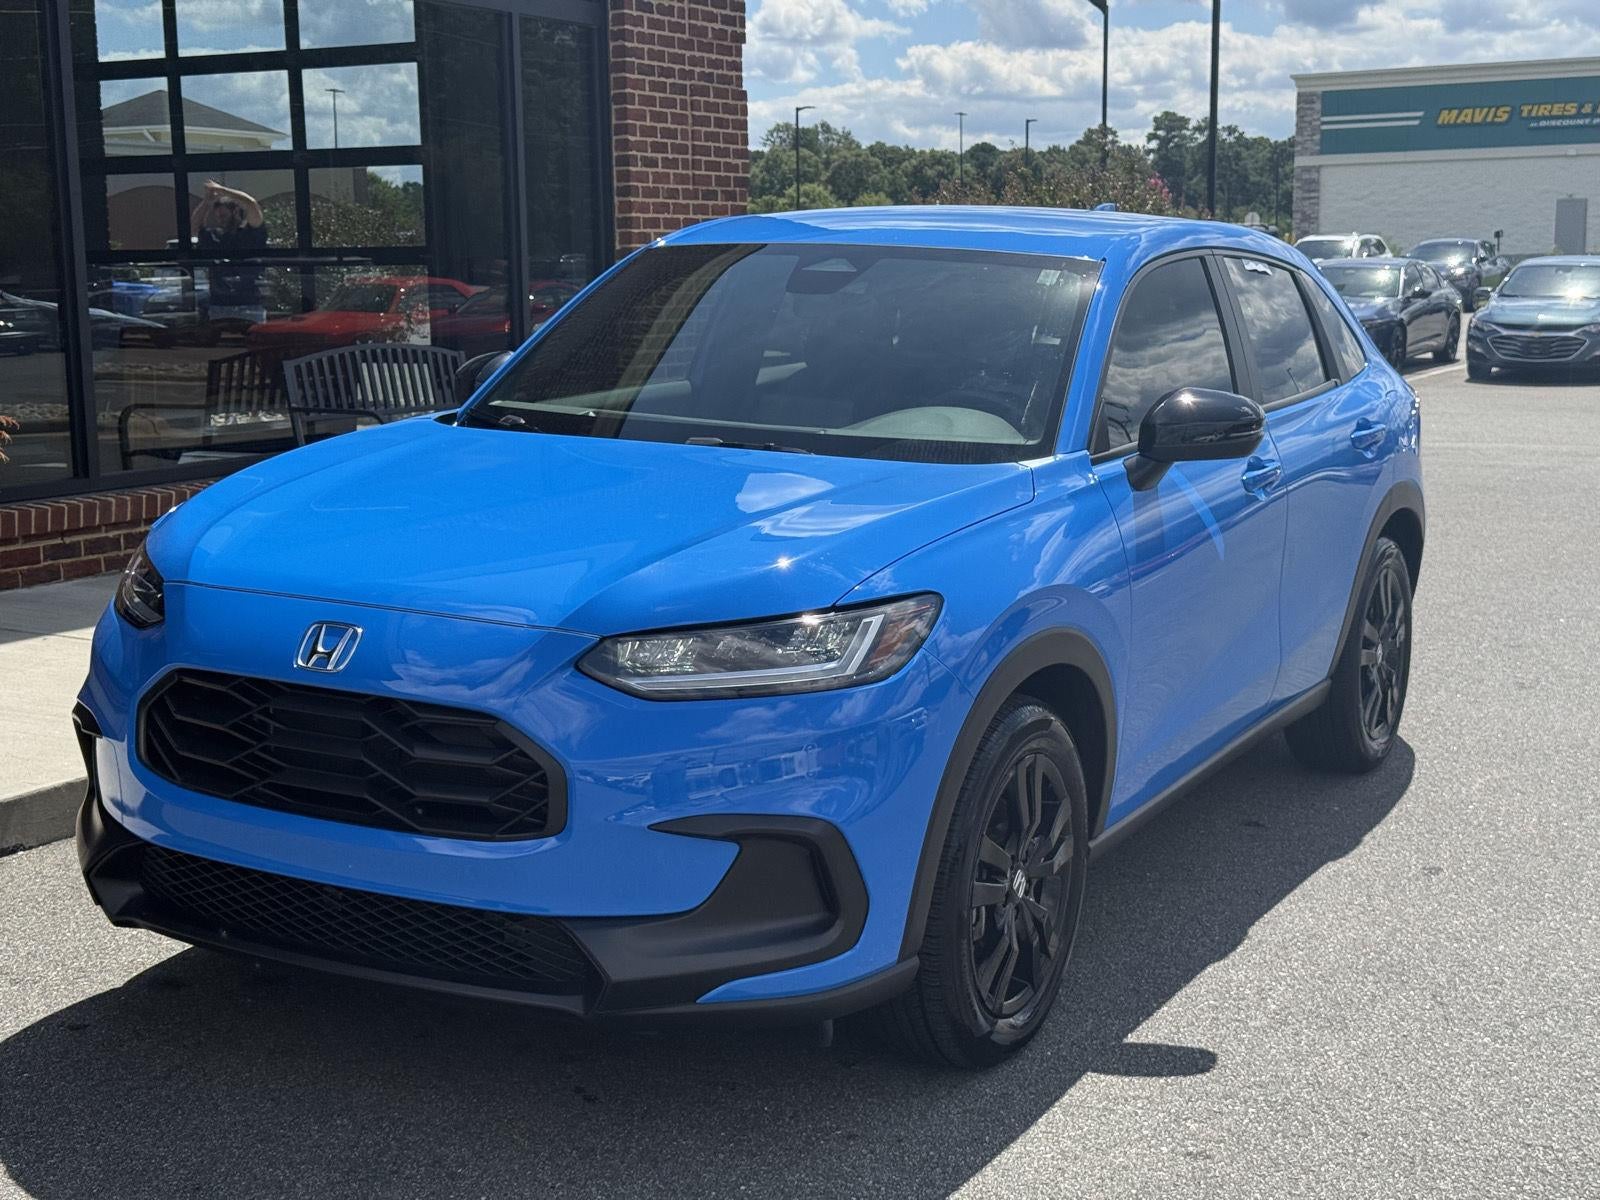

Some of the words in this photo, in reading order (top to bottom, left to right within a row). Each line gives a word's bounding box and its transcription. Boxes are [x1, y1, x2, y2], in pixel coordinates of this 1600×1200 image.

[1437, 106, 1513, 125] MAVIS
[1520, 102, 1578, 118] TIRES
[1581, 102, 1593, 114] &
